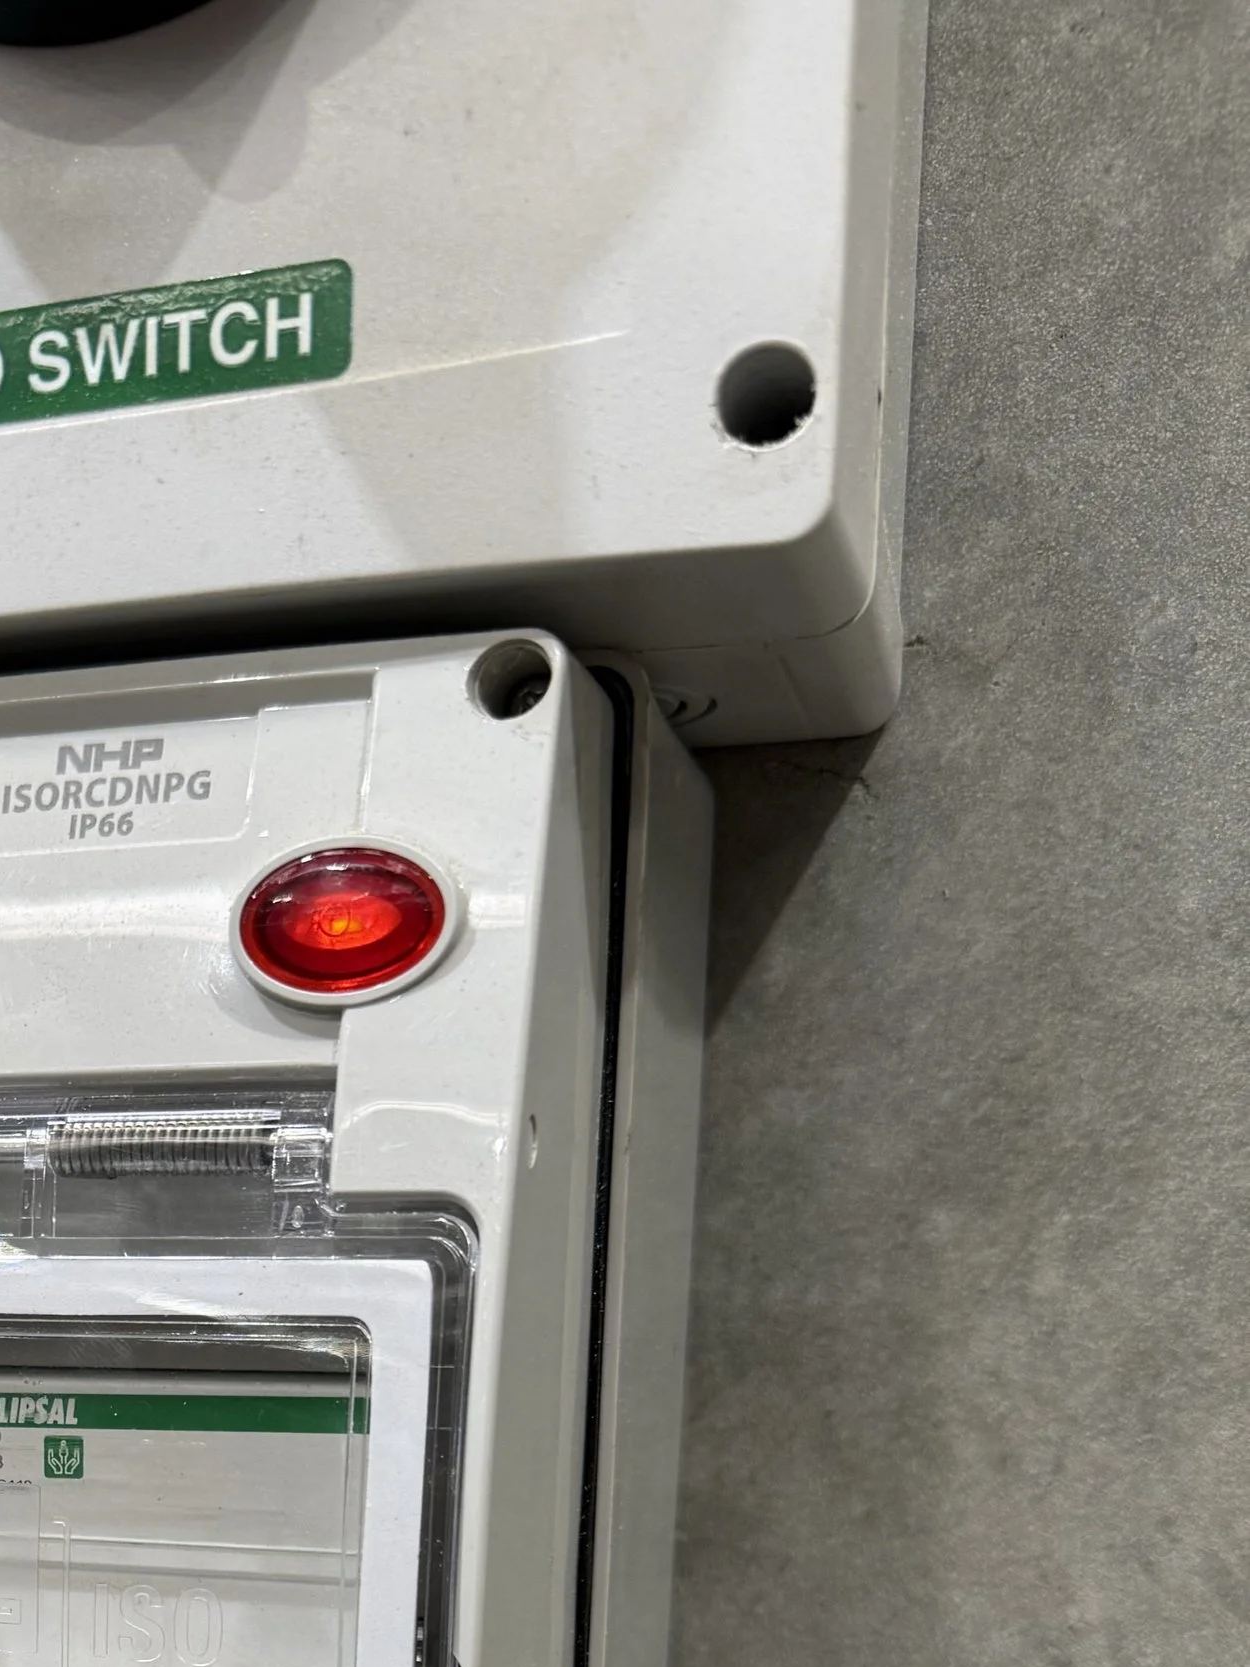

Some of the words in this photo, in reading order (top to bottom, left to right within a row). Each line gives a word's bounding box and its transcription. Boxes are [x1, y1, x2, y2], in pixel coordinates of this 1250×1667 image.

[28, 293, 313, 394] SWITCH
[56, 739, 164, 775] NHP
[2, 771, 211, 814] ISORCDNPG
[69, 811, 134, 840] IP66
[92, 1583, 223, 1667] ISO
